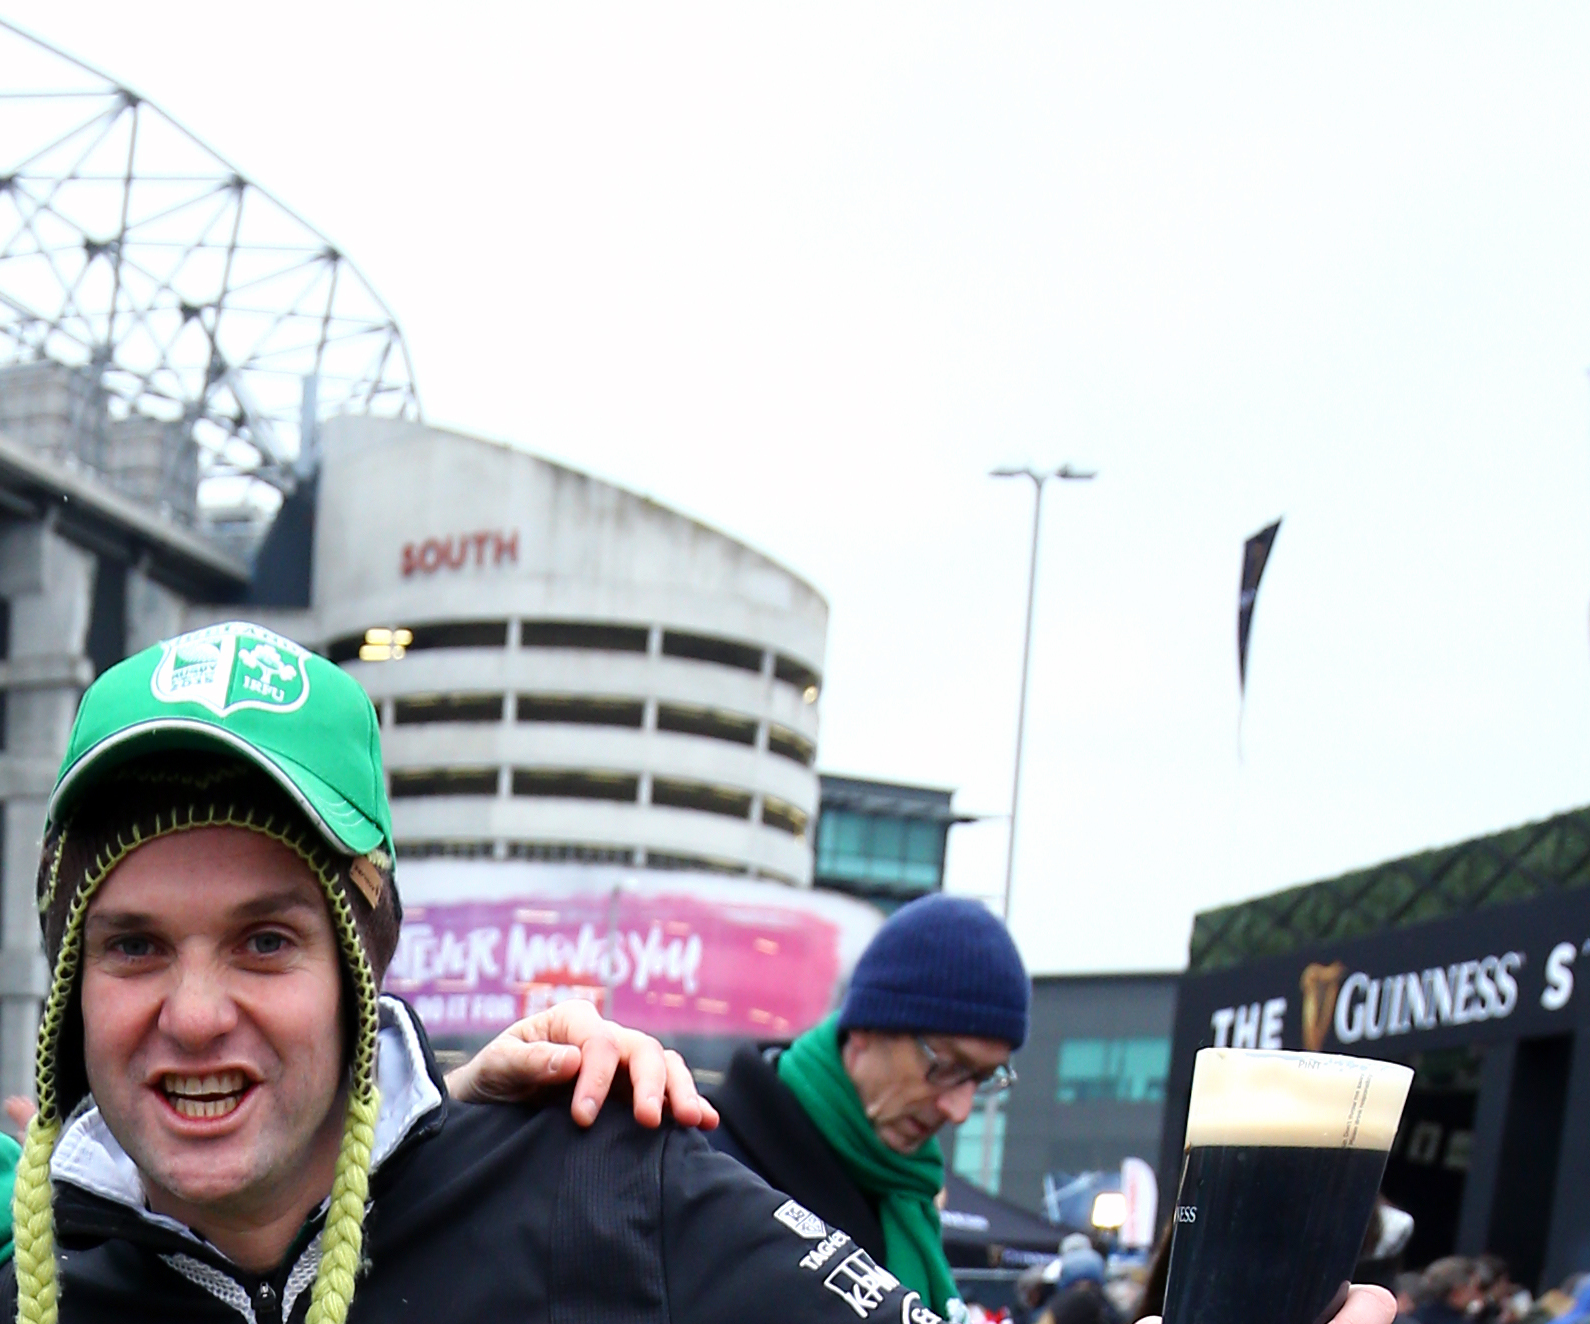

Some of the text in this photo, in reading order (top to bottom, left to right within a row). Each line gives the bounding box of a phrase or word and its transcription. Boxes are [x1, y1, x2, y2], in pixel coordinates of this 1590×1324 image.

[400, 527, 519, 578] SOUTH
[1211, 997, 1288, 1050] THE
[1334, 951, 1520, 1045] GUINNESS
[1298, 1059, 1322, 1070] PINT
